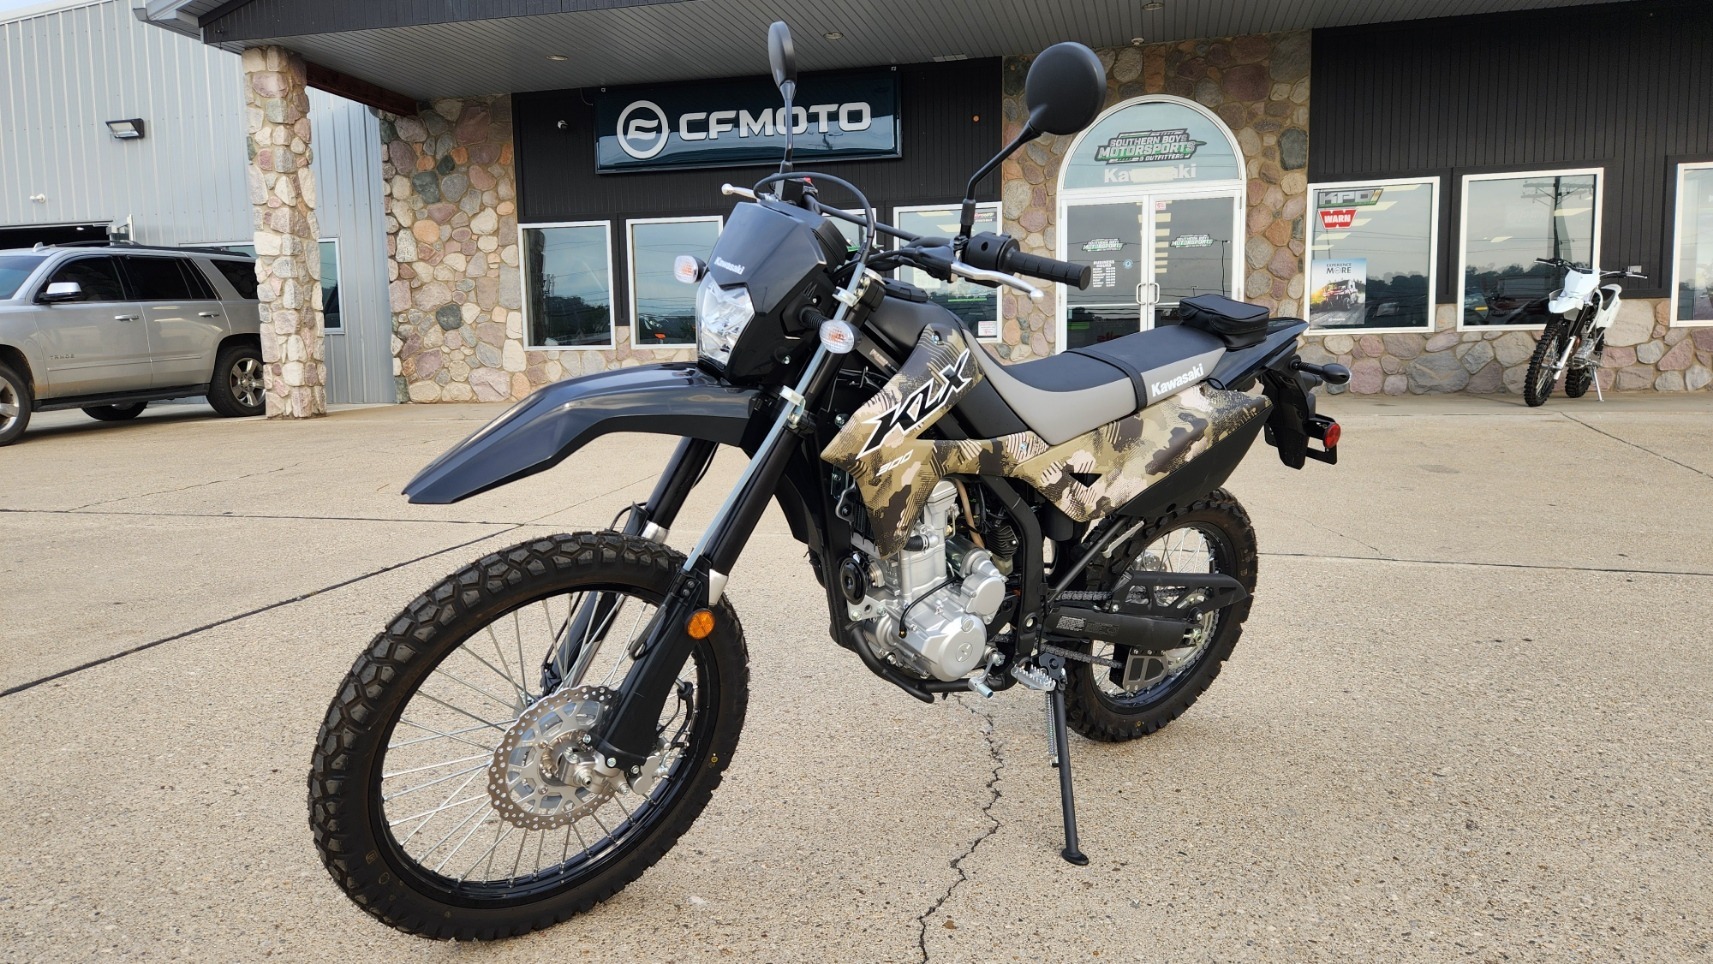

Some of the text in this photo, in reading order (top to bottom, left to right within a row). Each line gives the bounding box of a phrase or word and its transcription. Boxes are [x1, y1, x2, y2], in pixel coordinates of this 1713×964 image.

[679, 102, 872, 141] CFMOTO
[1097, 141, 1196, 160] MOTORSPORTS
[1109, 134, 1188, 148] SOUTHERN BOYS
[1145, 153, 1185, 161] OUTFITTERS
[1104, 164, 1197, 183] Kaaki
[1324, 214, 1351, 223] WARN
[714, 256, 745, 275] Kawasaki
[1151, 363, 1204, 397] Kawasaki
